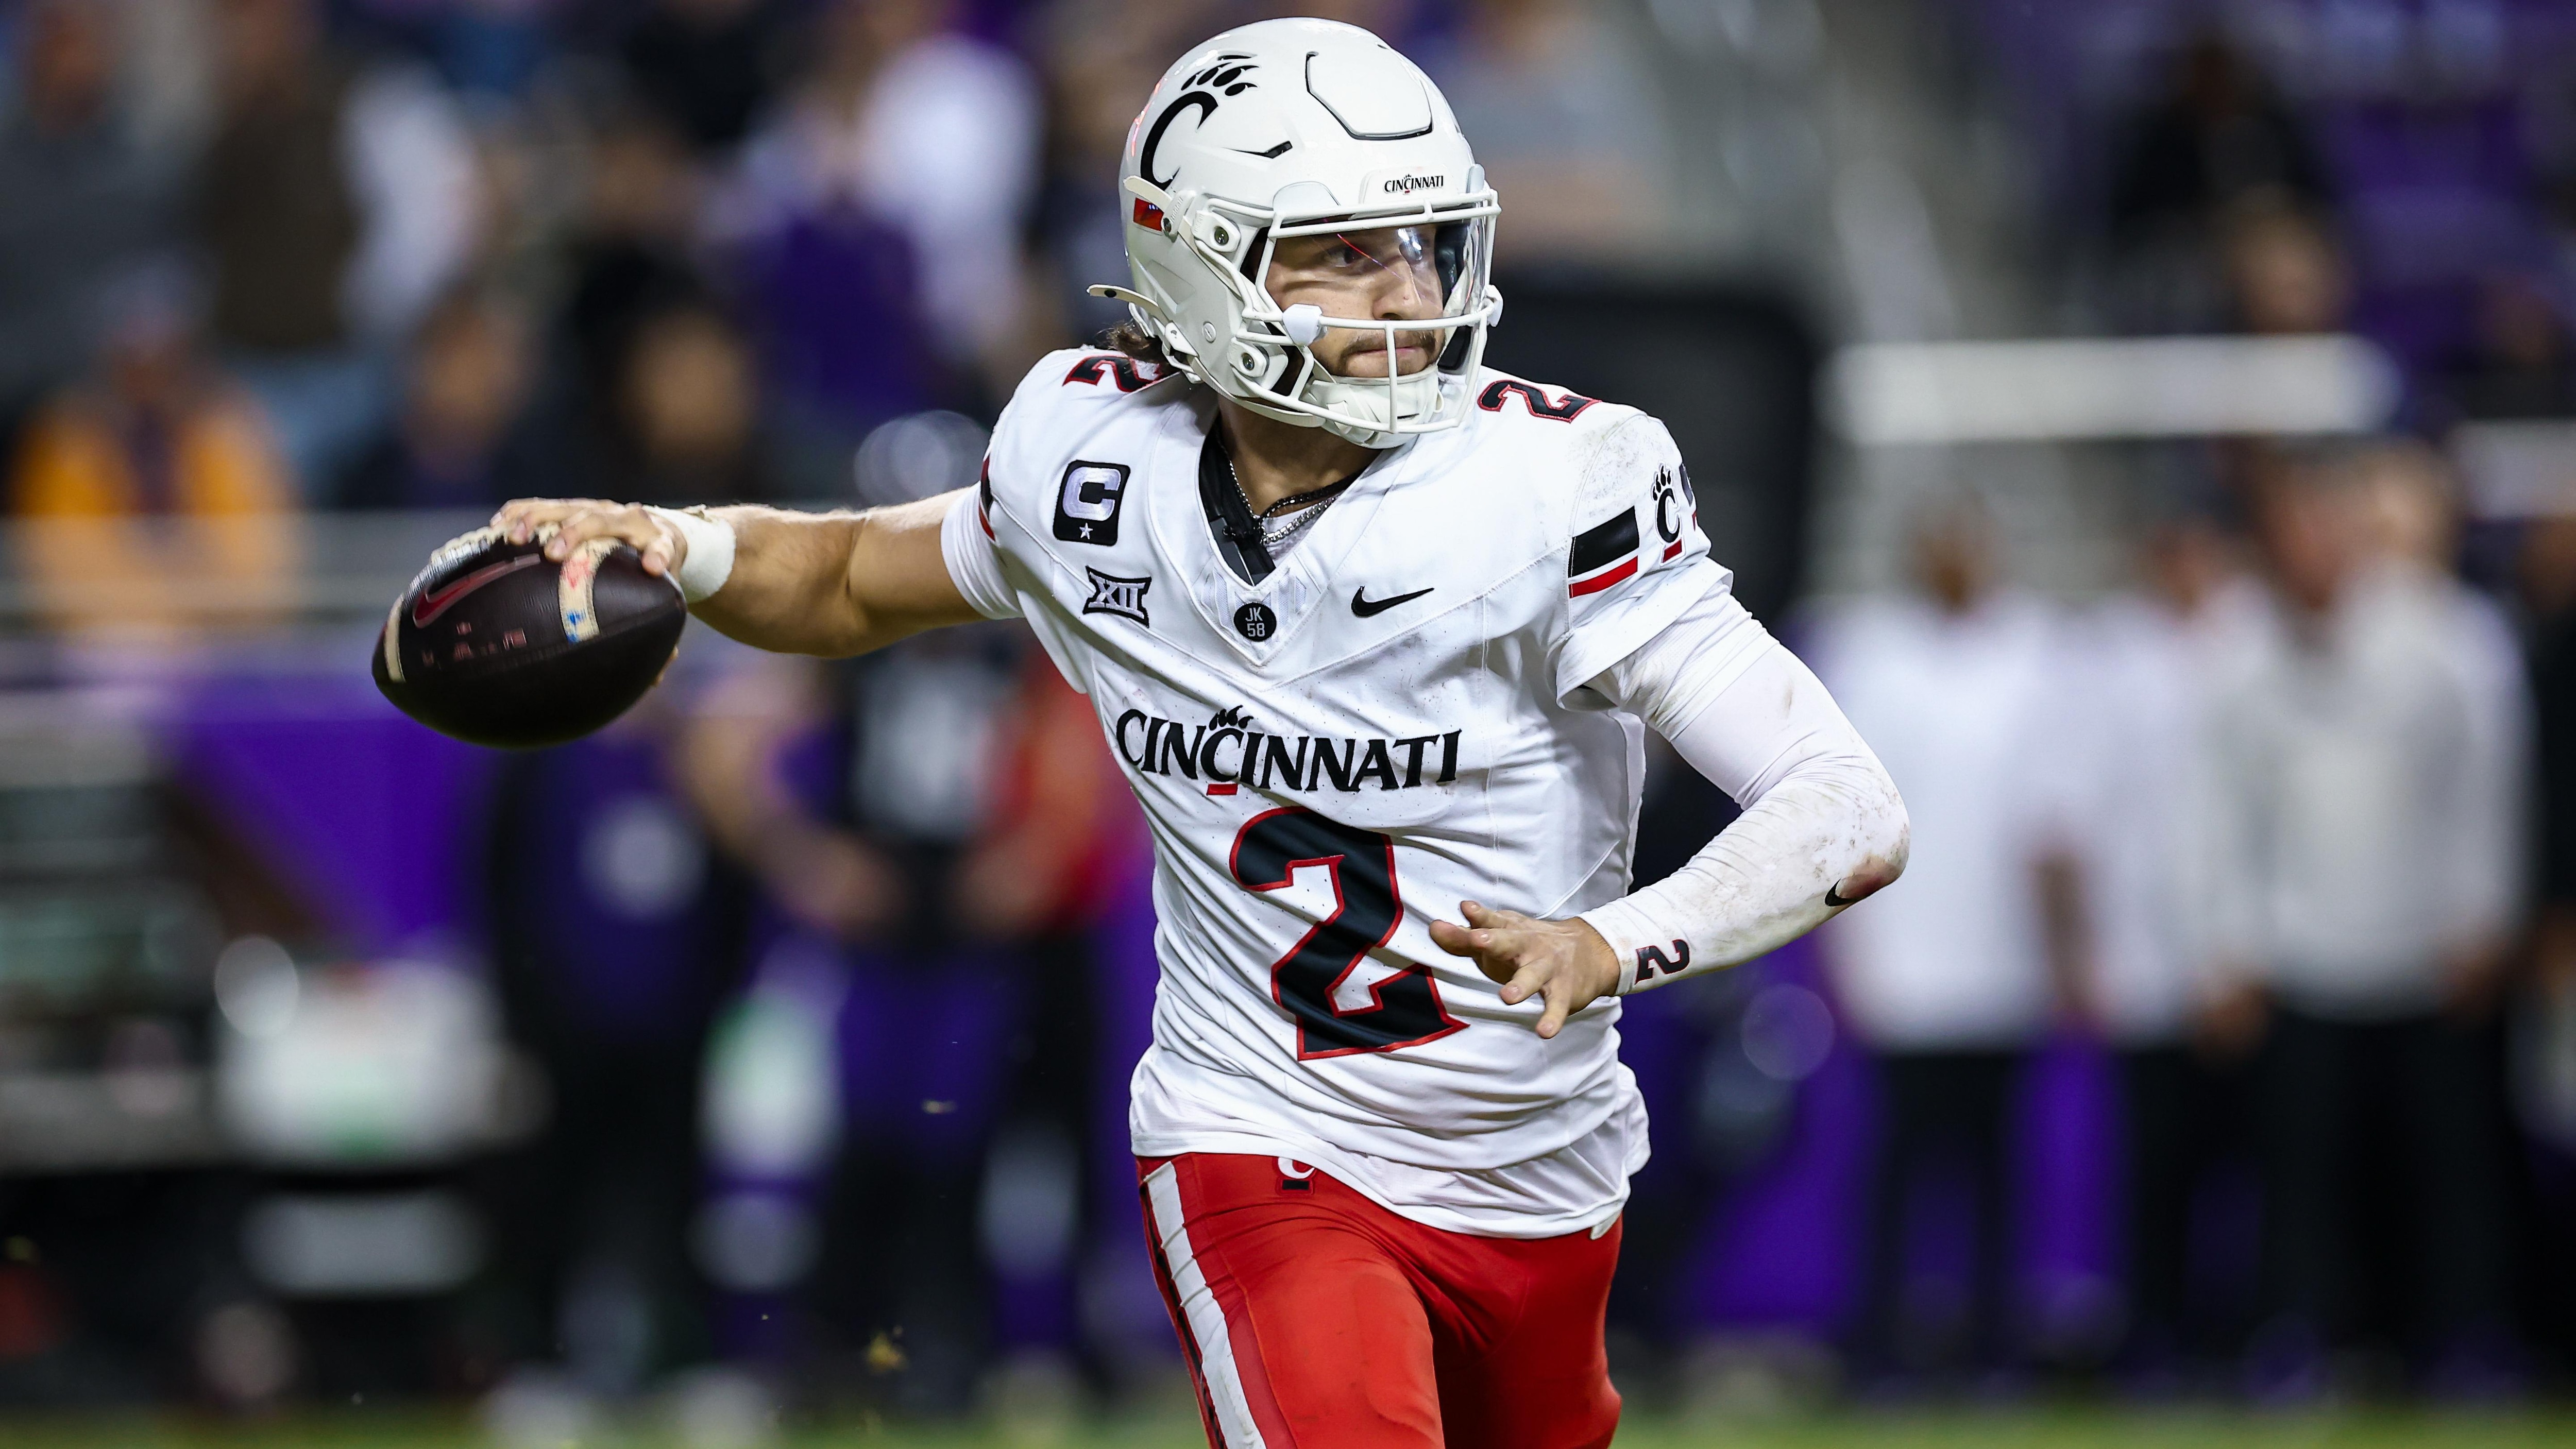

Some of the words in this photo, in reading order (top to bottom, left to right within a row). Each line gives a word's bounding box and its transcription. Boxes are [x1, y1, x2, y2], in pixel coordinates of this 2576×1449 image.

[1384, 175, 1444, 192] CINCINNATI
[1477, 380, 1602, 424] 2
[1062, 467, 1122, 521] C
[1245, 607, 1263, 622] JK
[1247, 622, 1266, 638] 58
[1116, 707, 1463, 793] CINCINNATI
[1229, 805, 1471, 1062] 2
[1634, 938, 1691, 986] 2
